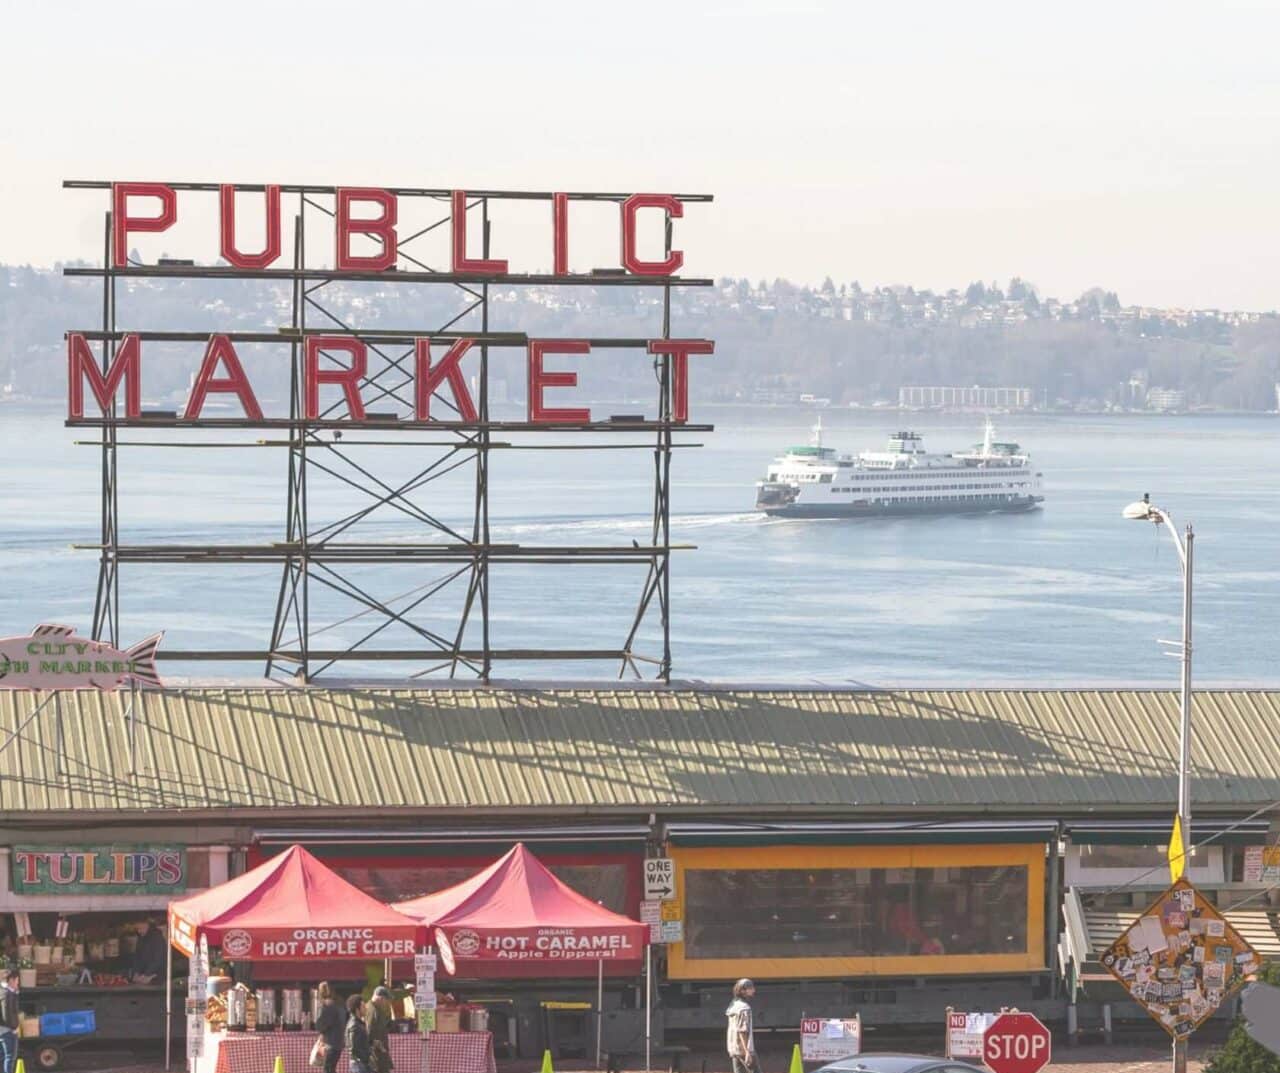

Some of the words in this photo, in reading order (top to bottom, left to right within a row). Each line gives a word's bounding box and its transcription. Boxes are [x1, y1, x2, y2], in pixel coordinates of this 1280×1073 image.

[113, 182, 684, 276] PUBLIC
[66, 334, 714, 424] MARKET
[26, 642, 88, 655] CITY
[40, 661, 136, 673] MARKET
[16, 852, 182, 884] TULIPS
[647, 861, 671, 872] ONE
[647, 873, 671, 883] WAY
[293, 929, 373, 940] ORGANIC
[538, 928, 575, 936] ORGANIC
[263, 942, 298, 956] HOT
[303, 941, 356, 955] APPLE
[362, 940, 415, 954] CIDER
[486, 937, 530, 950] HOT
[536, 935, 632, 950] CARAMEL
[497, 950, 543, 959] Apple
[550, 949, 616, 959] Dippers!
[804, 1021, 817, 1032] NO
[951, 1015, 965, 1027] NO
[987, 1034, 1046, 1060] STOP
